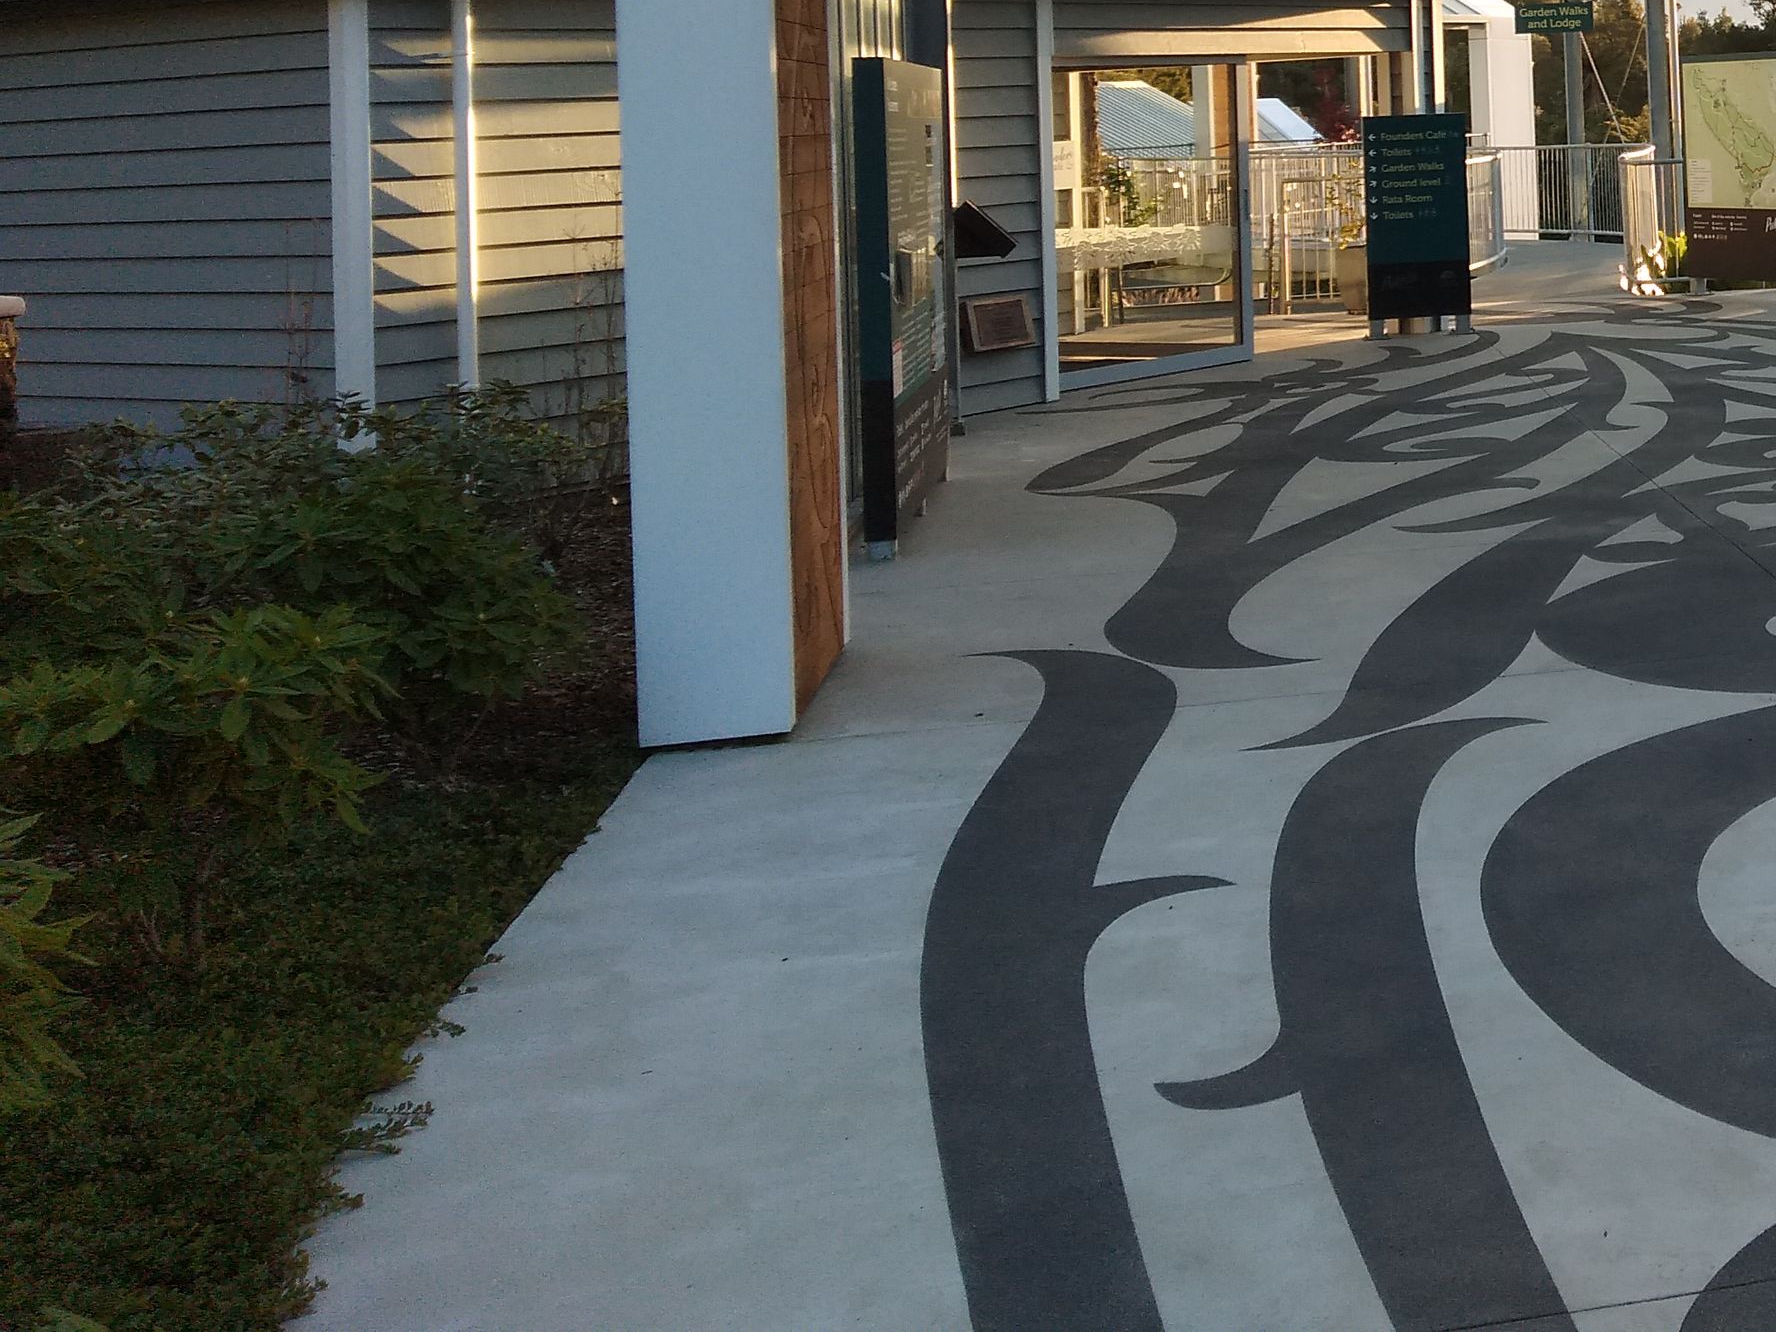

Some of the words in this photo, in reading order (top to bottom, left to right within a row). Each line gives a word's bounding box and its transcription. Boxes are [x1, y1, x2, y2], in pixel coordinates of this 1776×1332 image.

[1520, 7, 1557, 18] Garden
[1559, 6, 1588, 15] Walks
[1528, 19, 1547, 29] and
[1550, 18, 1581, 29] Lodge
[1380, 132, 1423, 141] Founders
[1381, 147, 1412, 156] Toilets
[1381, 164, 1415, 173] Garden
[1417, 162, 1444, 171] Walks
[1381, 179, 1417, 188] Ground
[1419, 178, 1441, 186] level
[1405, 194, 1432, 203] Room
[1382, 211, 1414, 220] Toilets
